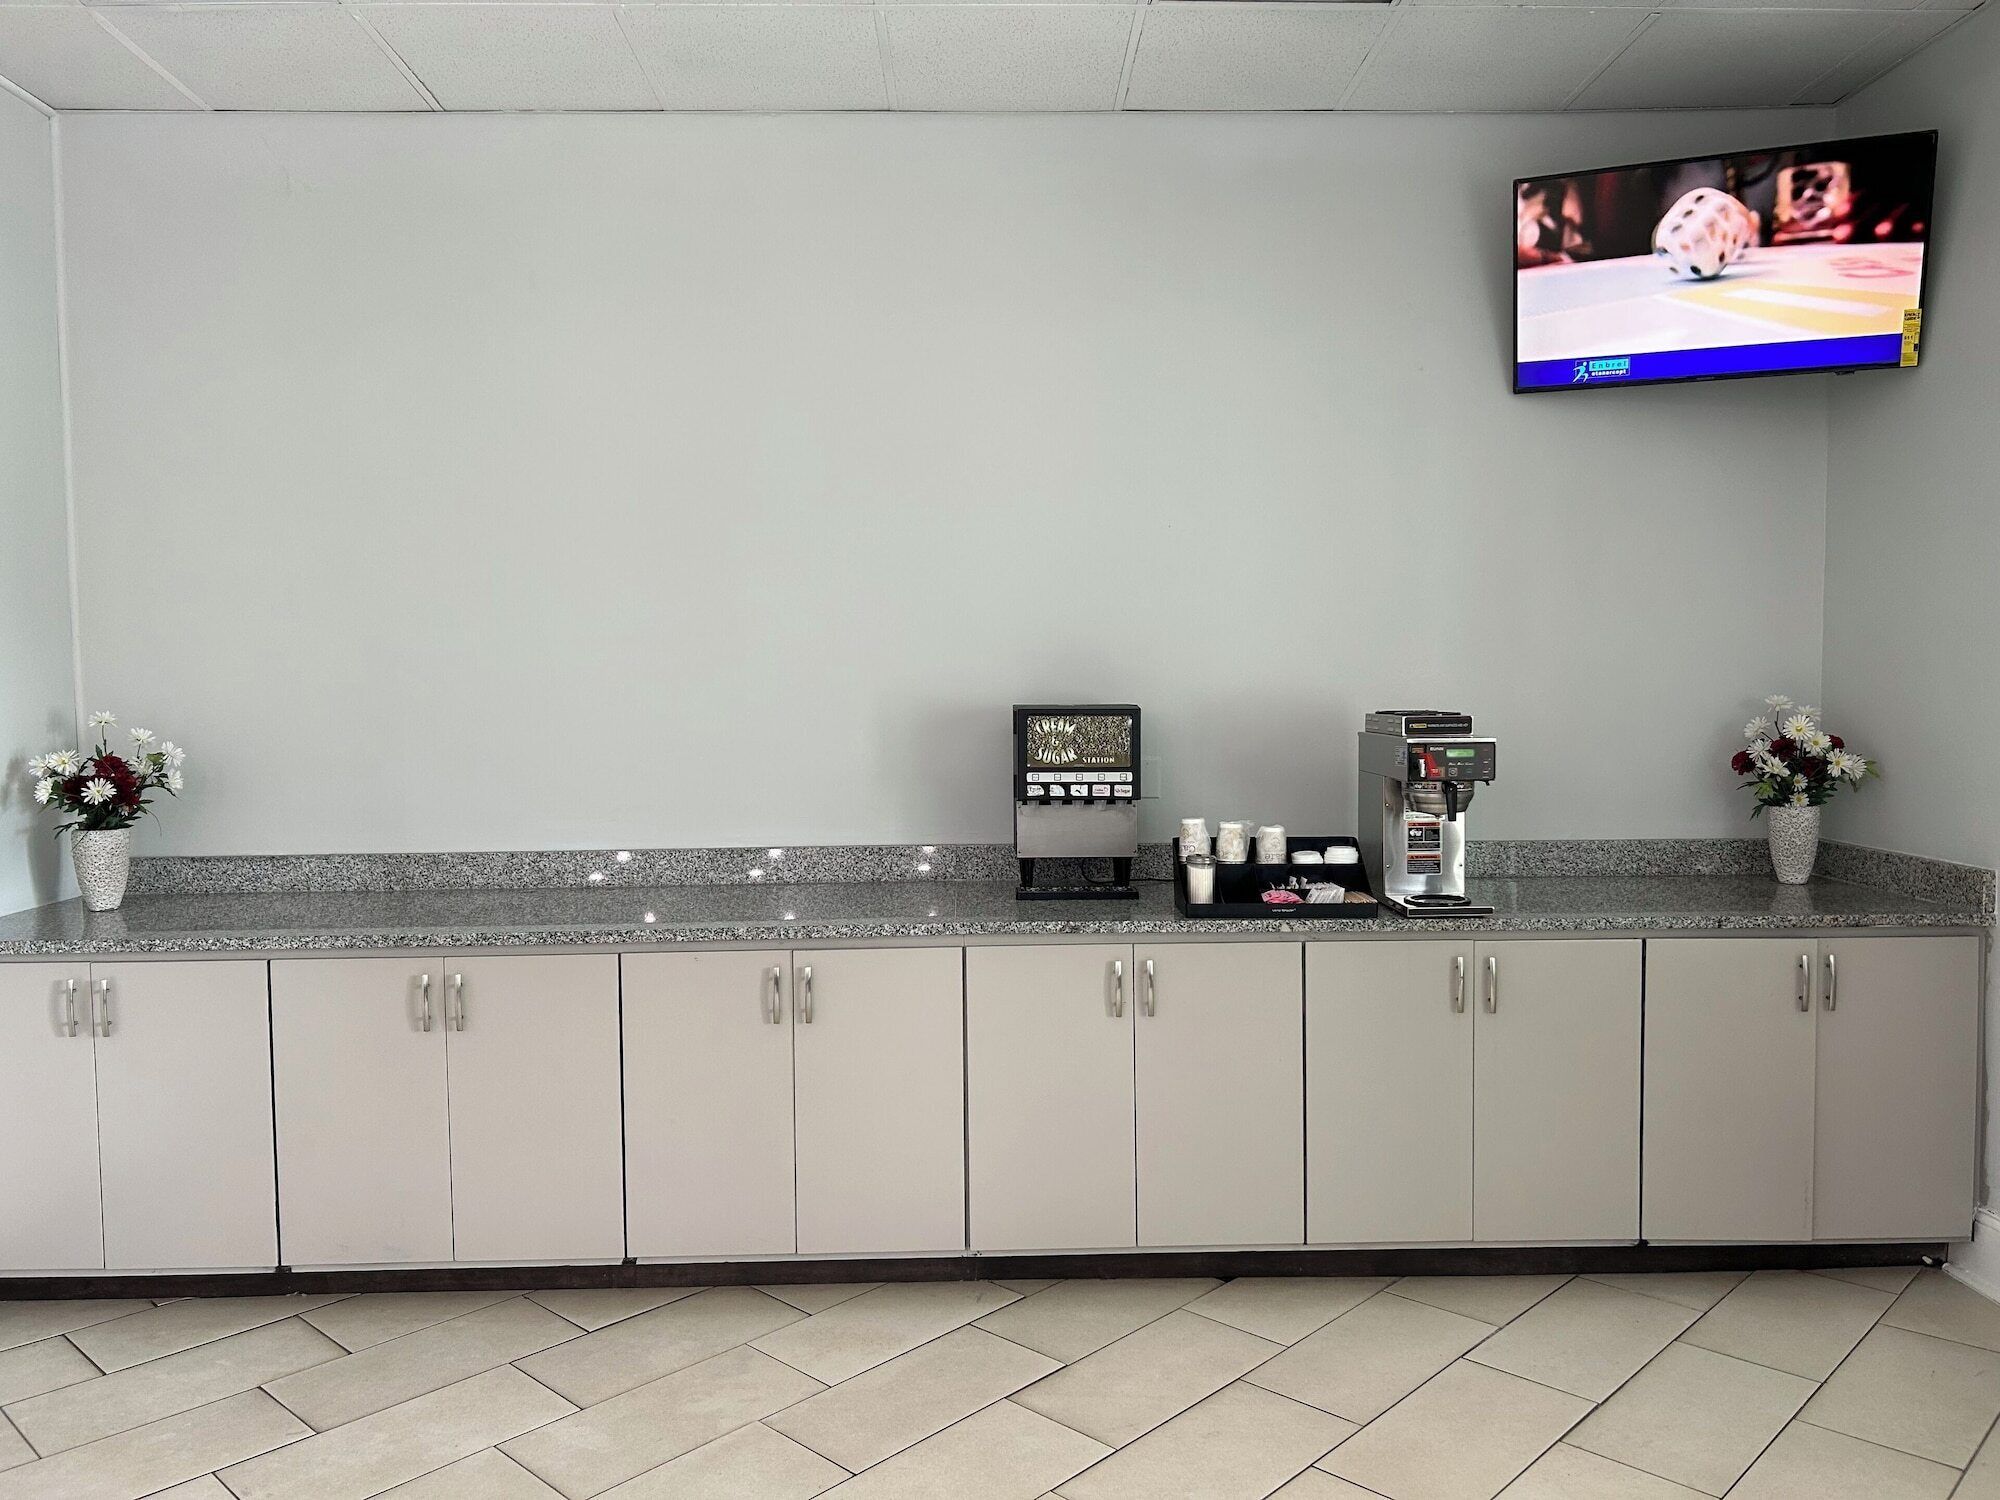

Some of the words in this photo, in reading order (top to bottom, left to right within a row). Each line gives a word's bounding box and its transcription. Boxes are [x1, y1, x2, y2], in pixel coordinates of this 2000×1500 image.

[1035, 718, 1077, 736] CREAM
[1051, 735, 1060, 747] &
[1034, 747, 1078, 764] SUGAR
[1082, 756, 1115, 764] STATION
